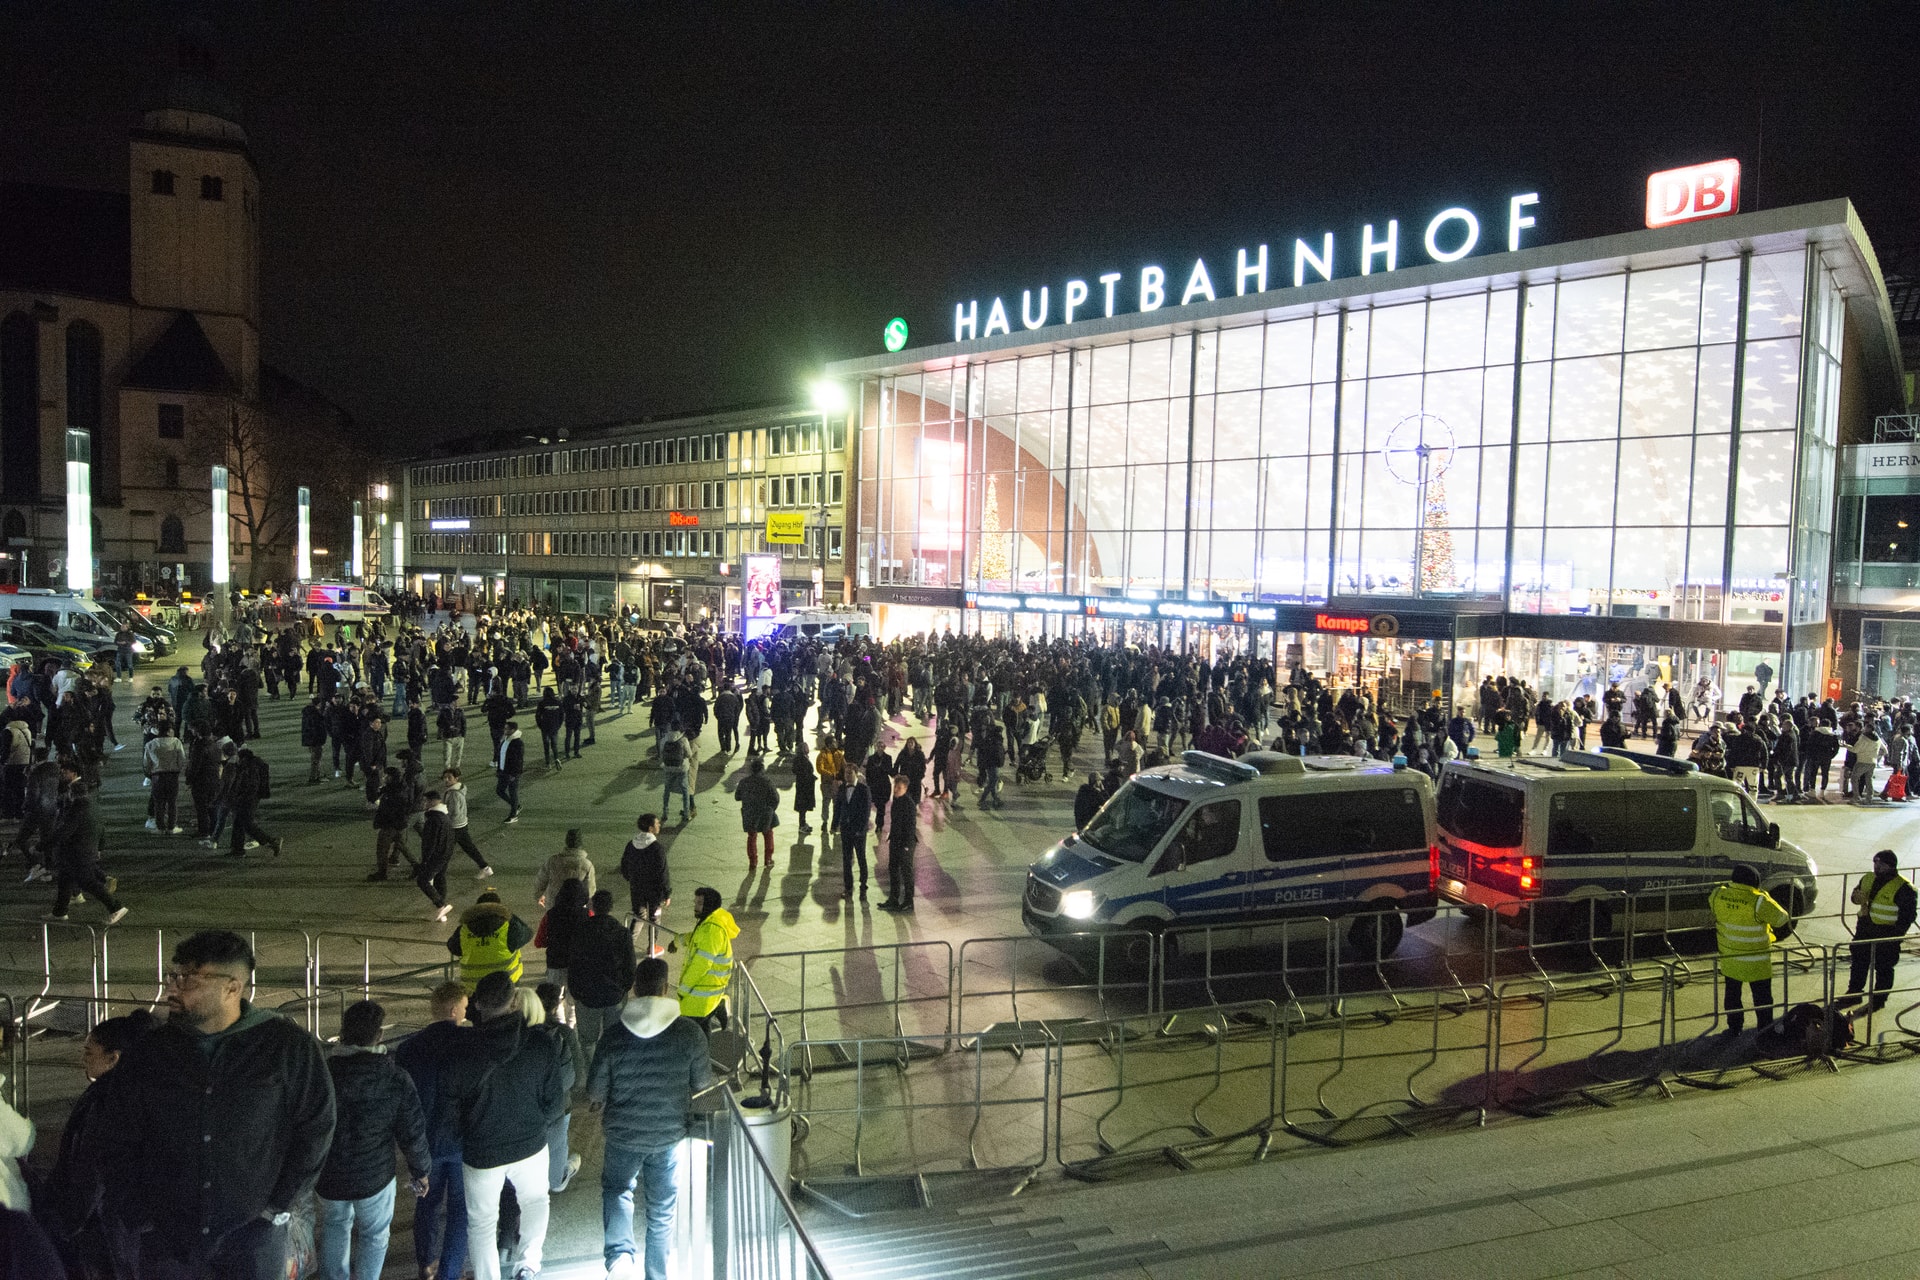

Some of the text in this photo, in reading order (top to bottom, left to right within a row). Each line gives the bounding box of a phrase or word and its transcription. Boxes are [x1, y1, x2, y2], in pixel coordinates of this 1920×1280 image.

[1659, 172, 1725, 217] DB
[954, 192, 1540, 343] HAUPTBAHNHOF
[886, 320, 905, 351] S
[771, 520, 803, 529] Zugang Hbf
[1315, 614, 1369, 634] Kamps
[1274, 887, 1323, 902] POLIZEI
